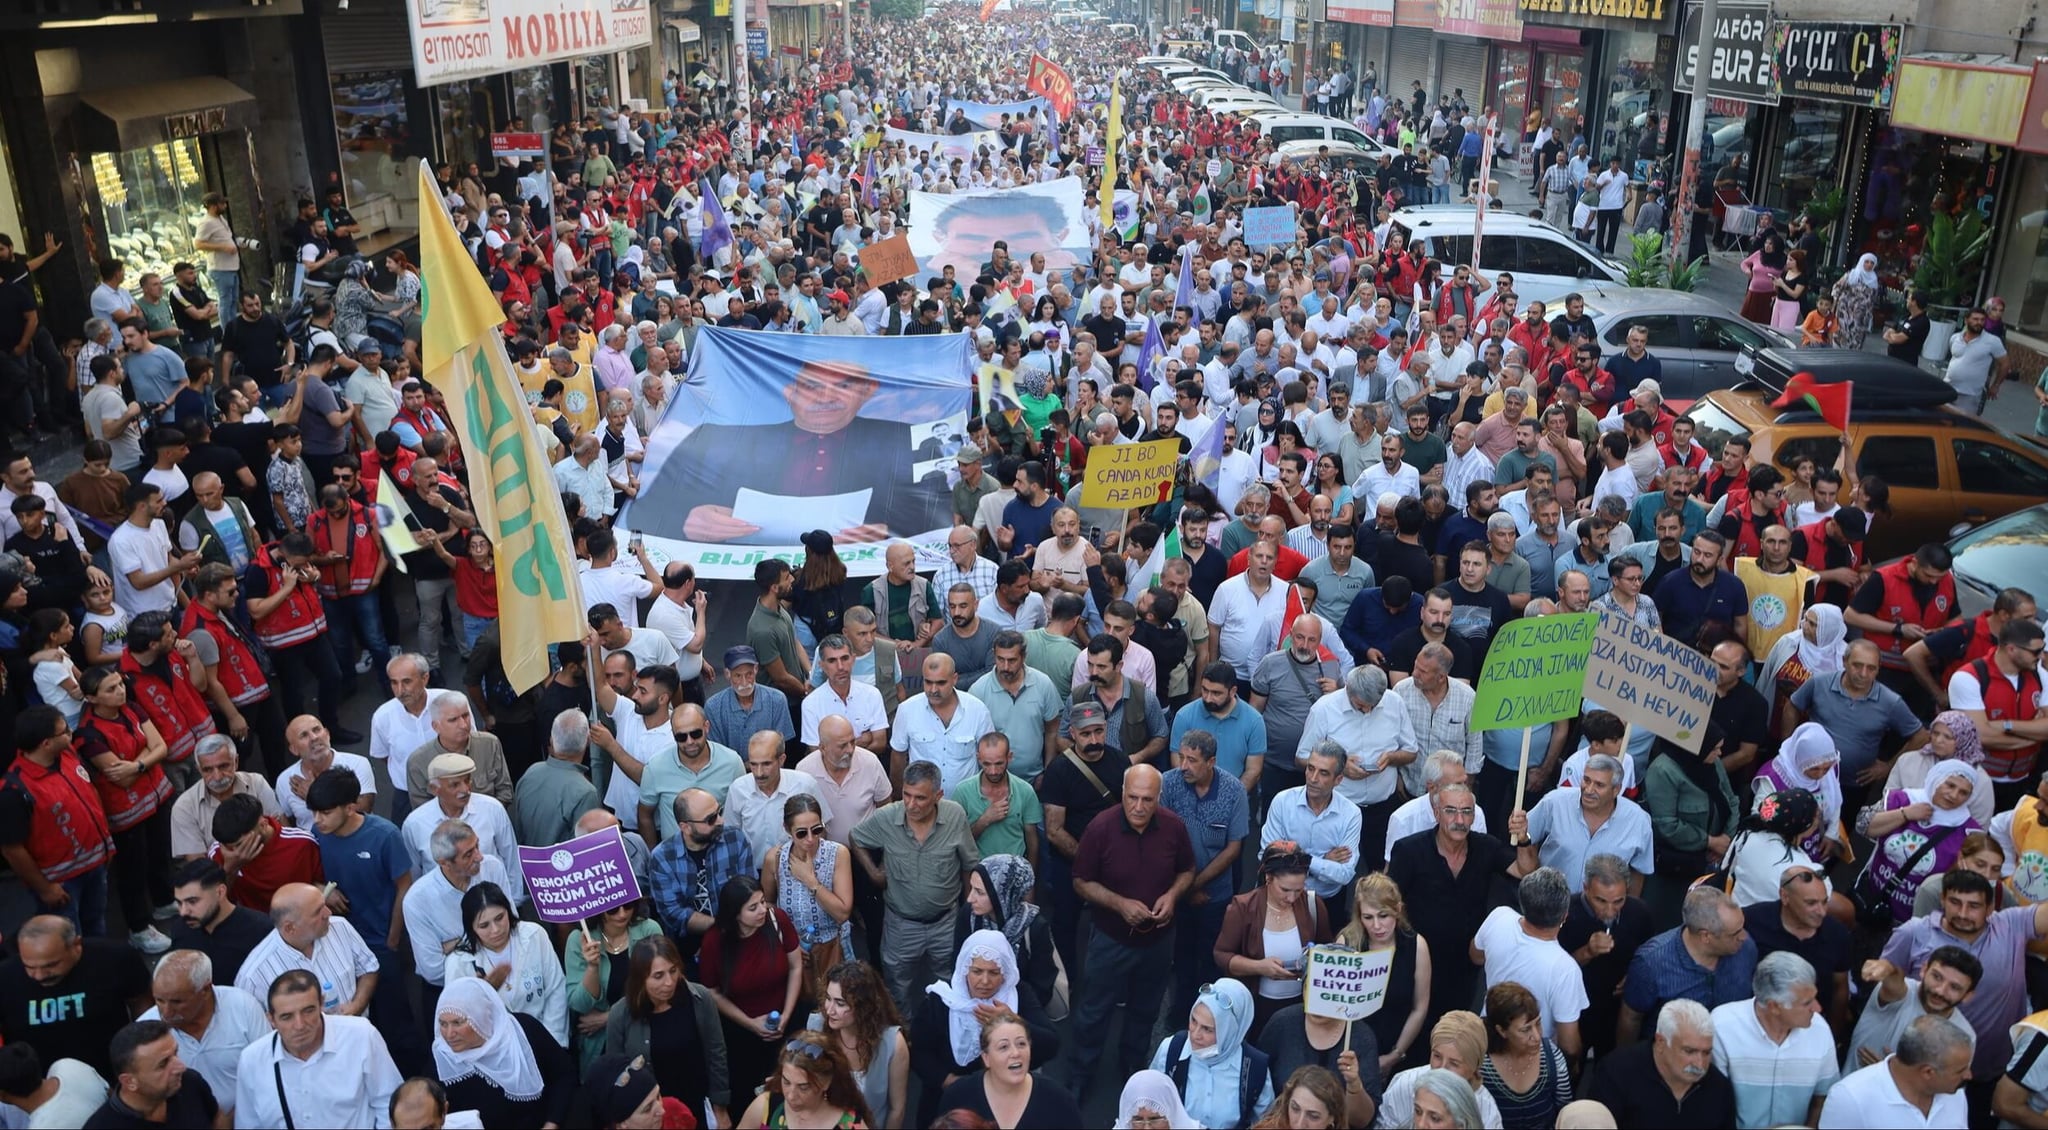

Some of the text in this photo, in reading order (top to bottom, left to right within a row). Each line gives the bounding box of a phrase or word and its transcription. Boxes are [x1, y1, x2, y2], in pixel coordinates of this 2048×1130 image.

[503, 3, 607, 59] MOBİLYA
[424, 32, 492, 64] ermosan
[1686, 45, 1754, 84] SBUR
[1112, 446, 1157, 463] JI BO
[1097, 469, 1140, 484] ÇANDA
[780, 546, 879, 566] SEOK
[1612, 616, 1630, 638] JI
[1493, 630, 1517, 653] EM
[1482, 652, 1590, 686] AZADIYA JINAN
[1618, 651, 1666, 687] ASTIYA
[1666, 672, 1713, 706] JINAN
[1596, 670, 1614, 690] LI
[1617, 680, 1637, 704] BA
[531, 860, 618, 888] DEMOKRATİK
[537, 873, 624, 906] ÇÖZÜM İÇİN
[542, 889, 628, 916] KADINLAR YÜRÜYOR!
[1313, 953, 1363, 971] BARIŞ
[1324, 965, 1388, 980] KADININ
[29, 992, 86, 1025] LOFT
[1320, 988, 1383, 1005] GELECEK
